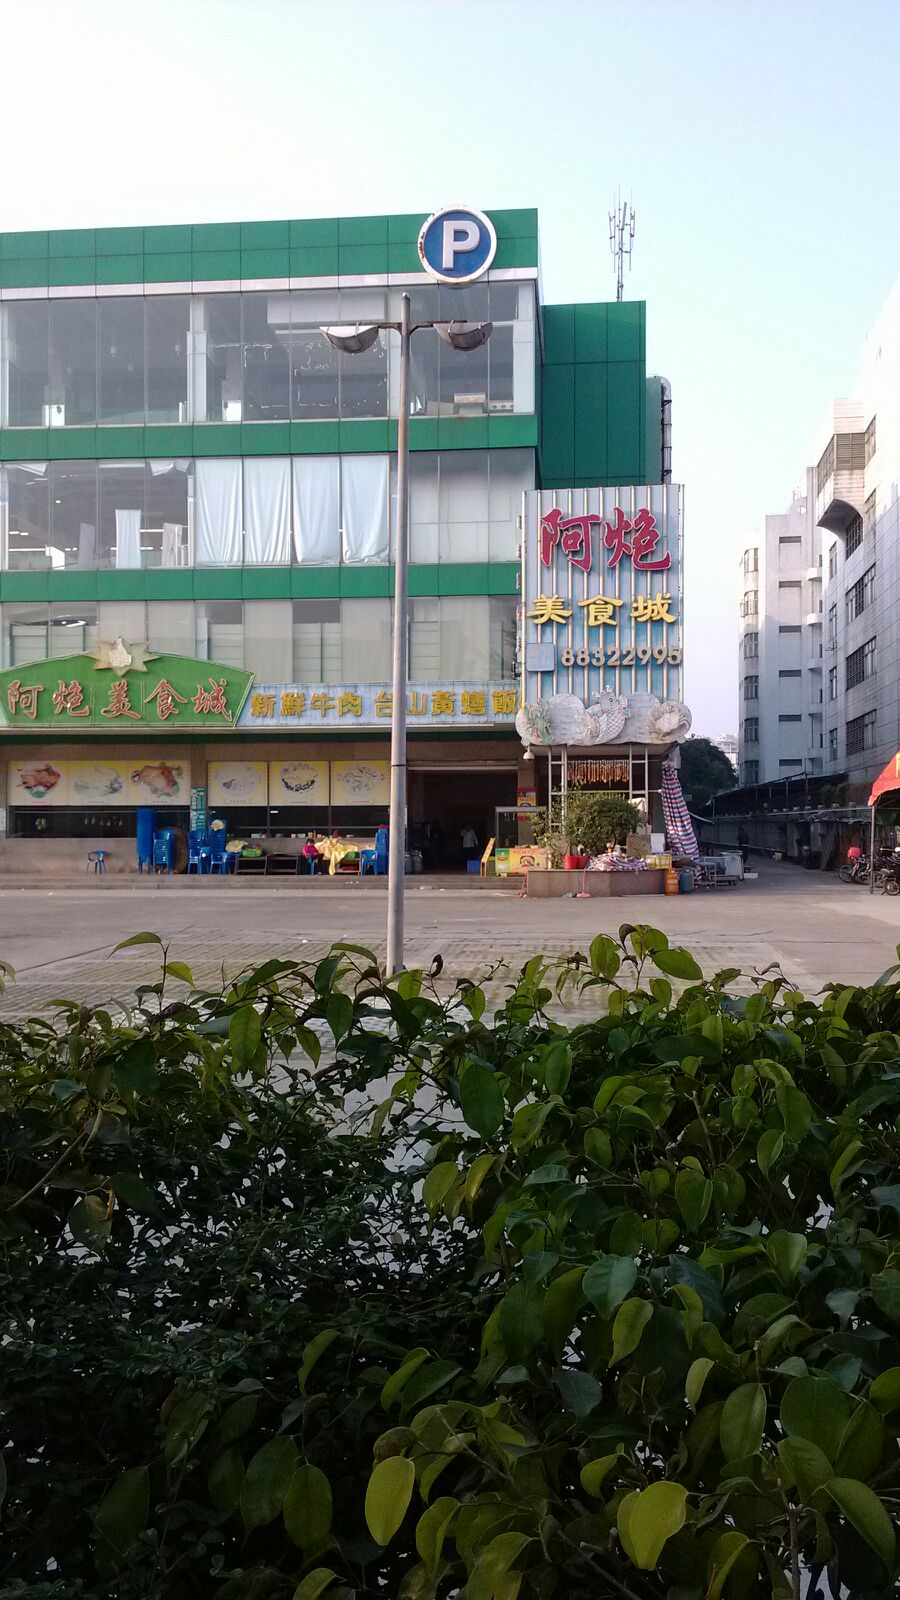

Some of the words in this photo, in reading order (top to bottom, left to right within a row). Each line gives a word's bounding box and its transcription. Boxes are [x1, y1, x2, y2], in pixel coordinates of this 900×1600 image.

[443, 221, 480, 271] P
[527, 592, 677, 627] 美食城
[561, 645, 682, 667] 88322995
[250, 690, 363, 718] 新鮮牛肉
